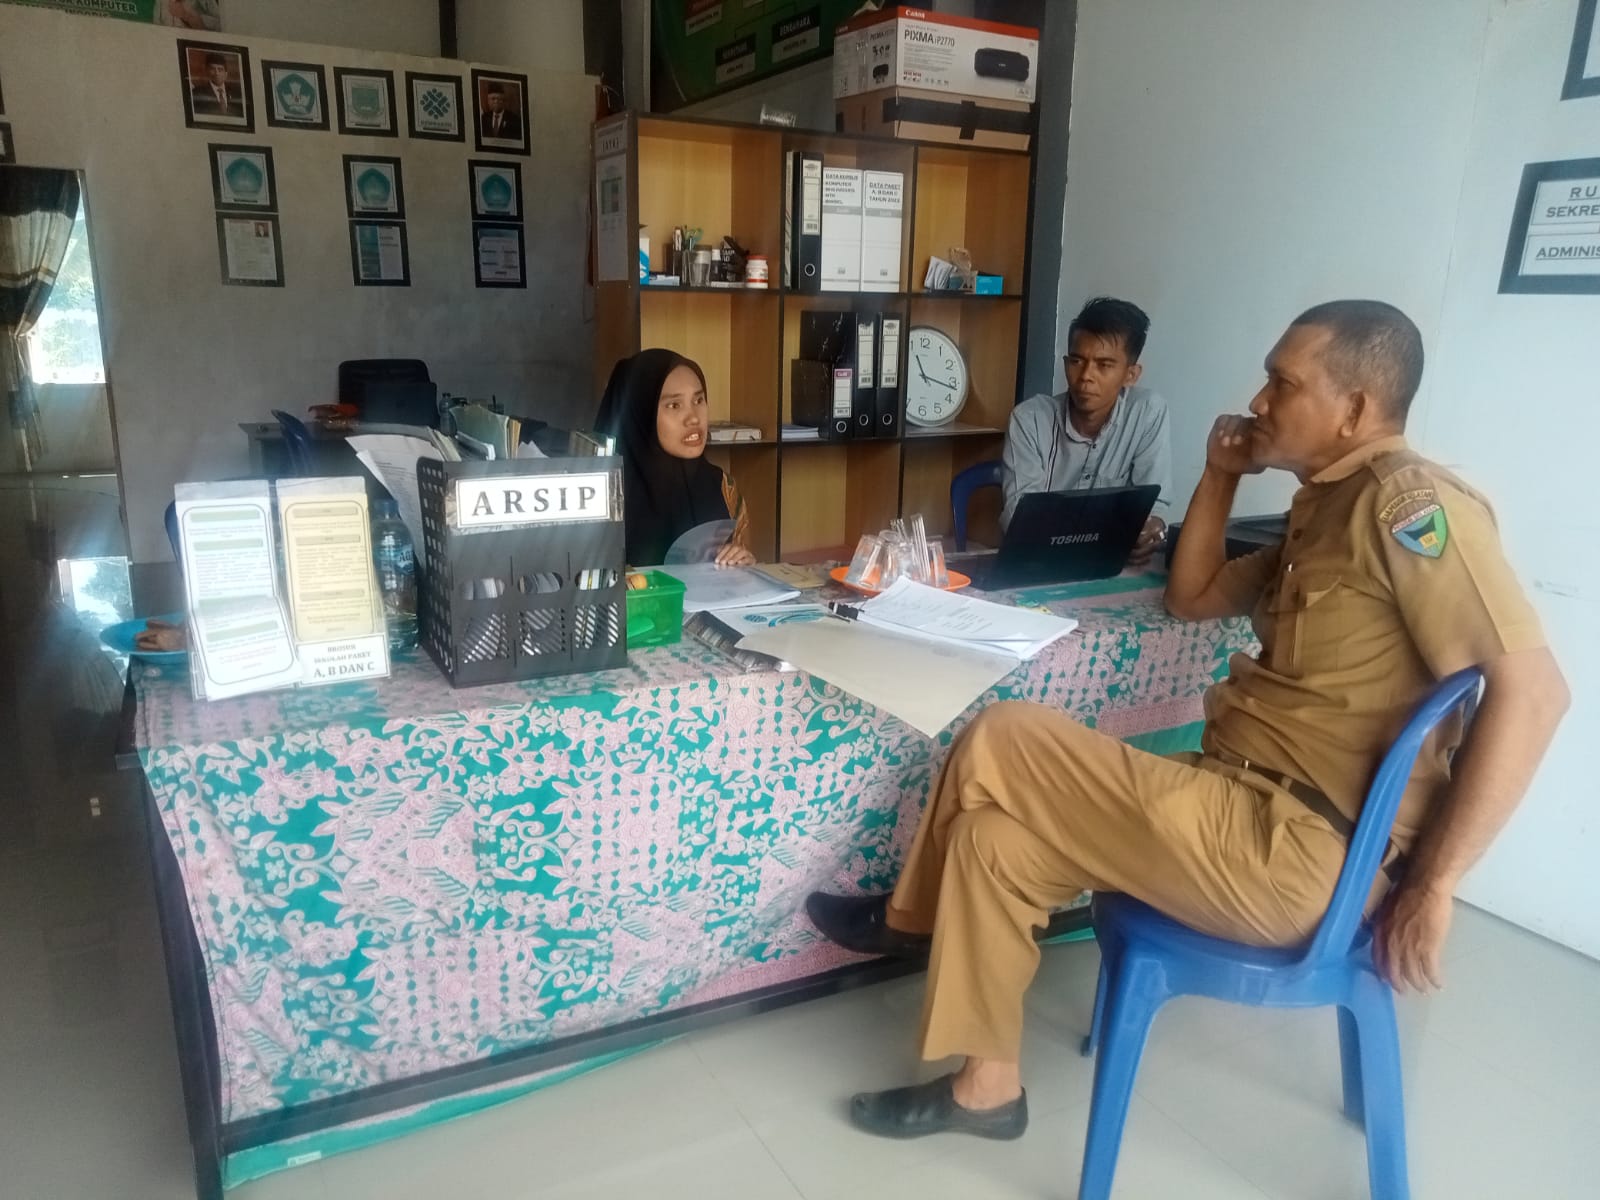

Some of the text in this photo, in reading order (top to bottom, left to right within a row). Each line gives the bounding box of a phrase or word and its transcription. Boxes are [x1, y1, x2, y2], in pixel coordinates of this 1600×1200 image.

[905, 9, 925, 19] Canon
[904, 29, 934, 44] PIXMA
[934, 36, 955, 47] iP2770
[920, 338, 931, 349] 12
[945, 359, 954, 370] 2
[948, 377, 957, 389] 3
[945, 393, 952, 404] 4
[918, 405, 927, 417] 6
[934, 403, 942, 414] 5
[472, 486, 596, 516] ARSIP
[1050, 533, 1099, 545] TOSHIBA
[348, 651, 371, 660] PAKET
[328, 666, 336, 675] B
[339, 663, 364, 674] DAN
[367, 661, 375, 671] C
